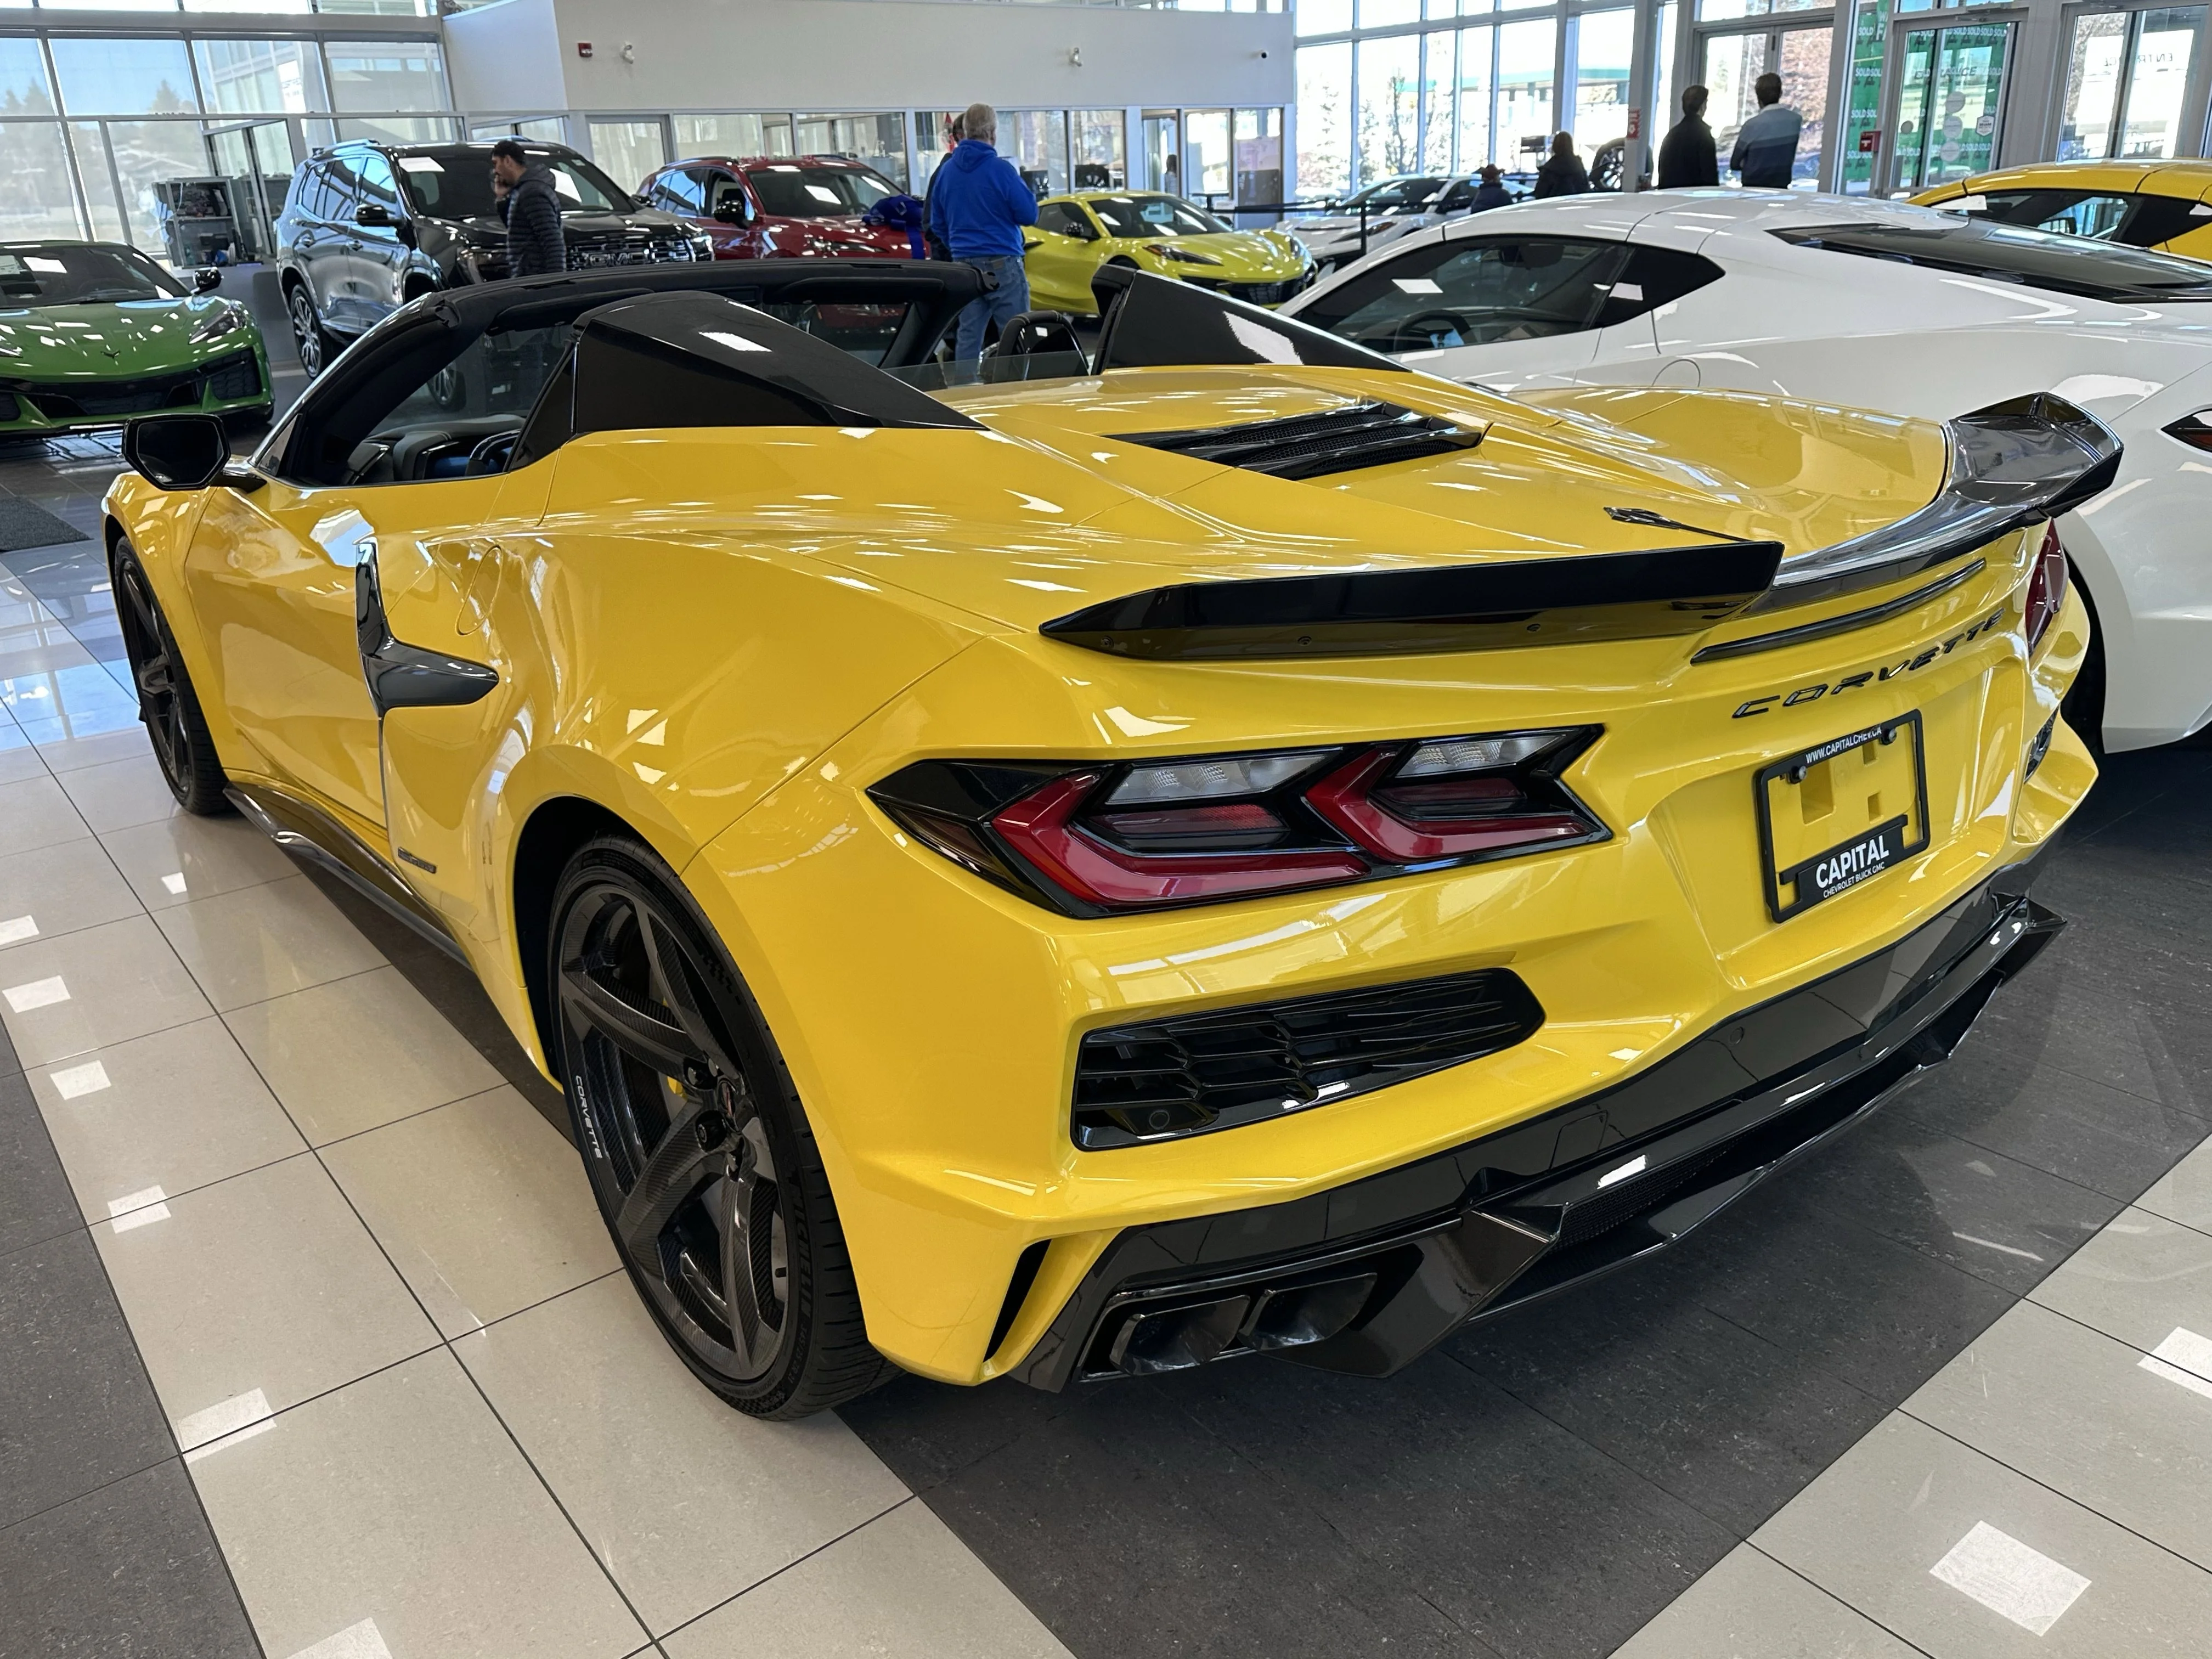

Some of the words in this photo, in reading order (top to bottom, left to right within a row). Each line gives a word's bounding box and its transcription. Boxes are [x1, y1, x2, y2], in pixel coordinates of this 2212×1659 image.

[1858, 26, 1874, 36] SOLD
[1871, 67, 1882, 77] SOL
[1731, 607, 2006, 719] CORVETTE
[1805, 726, 1882, 764] WWW.CAPITALCHEV.CA
[1816, 835, 1889, 888] CAPITAL
[1823, 876, 1854, 898] CHEVROLET
[1855, 868, 1872, 882] BUICK
[1872, 862, 1885, 873] GMC
[575, 1075, 603, 1159] CORVETTE
[789, 1183, 811, 1318] MICHELIN
